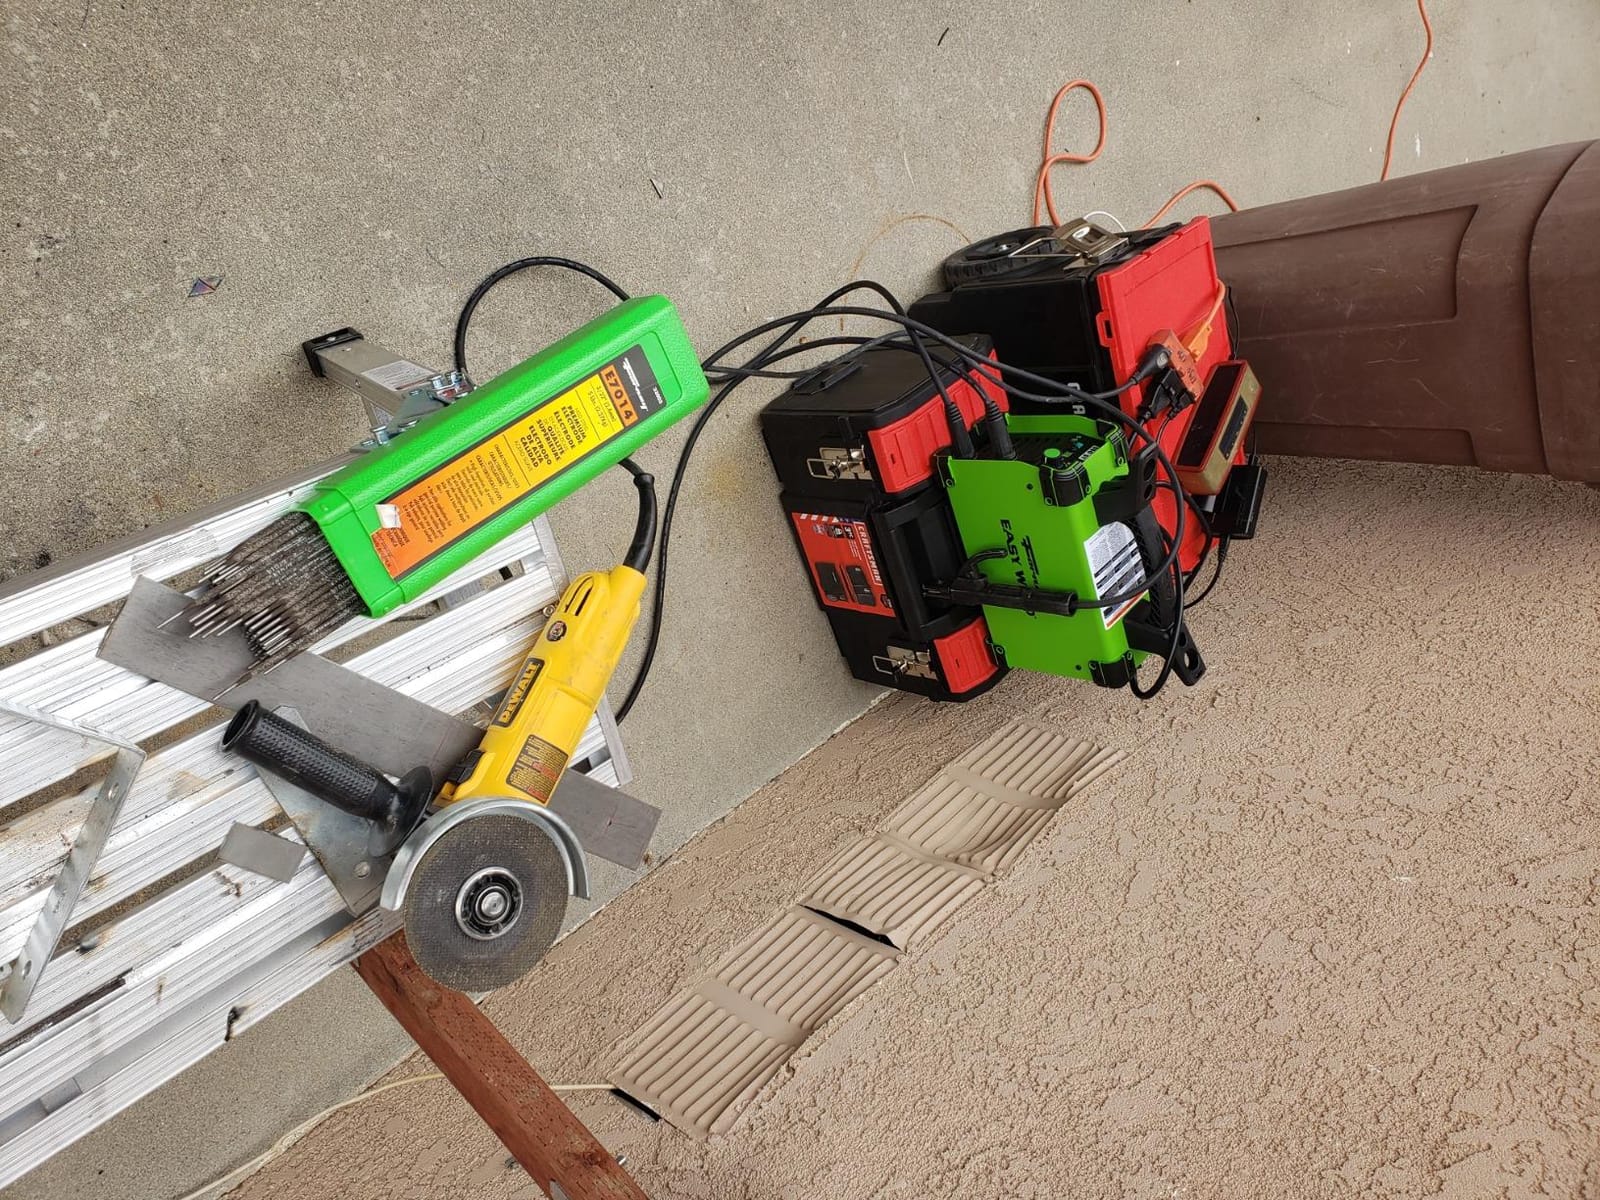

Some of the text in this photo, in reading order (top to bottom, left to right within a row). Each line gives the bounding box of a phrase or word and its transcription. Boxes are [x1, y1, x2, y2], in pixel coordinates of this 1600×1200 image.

[605, 370, 633, 420] E7014
[560, 406, 583, 444] ELECTRODE
[566, 405, 587, 439] PREMIUM
[519, 436, 539, 468] CALIDAD
[526, 434, 544, 463] DE ALTA
[528, 425, 552, 465] ELECTRODO
[858, 526, 882, 582] CRAFTSMAN
[1000, 519, 1022, 566] EASY
[499, 662, 539, 723] DEWALT
